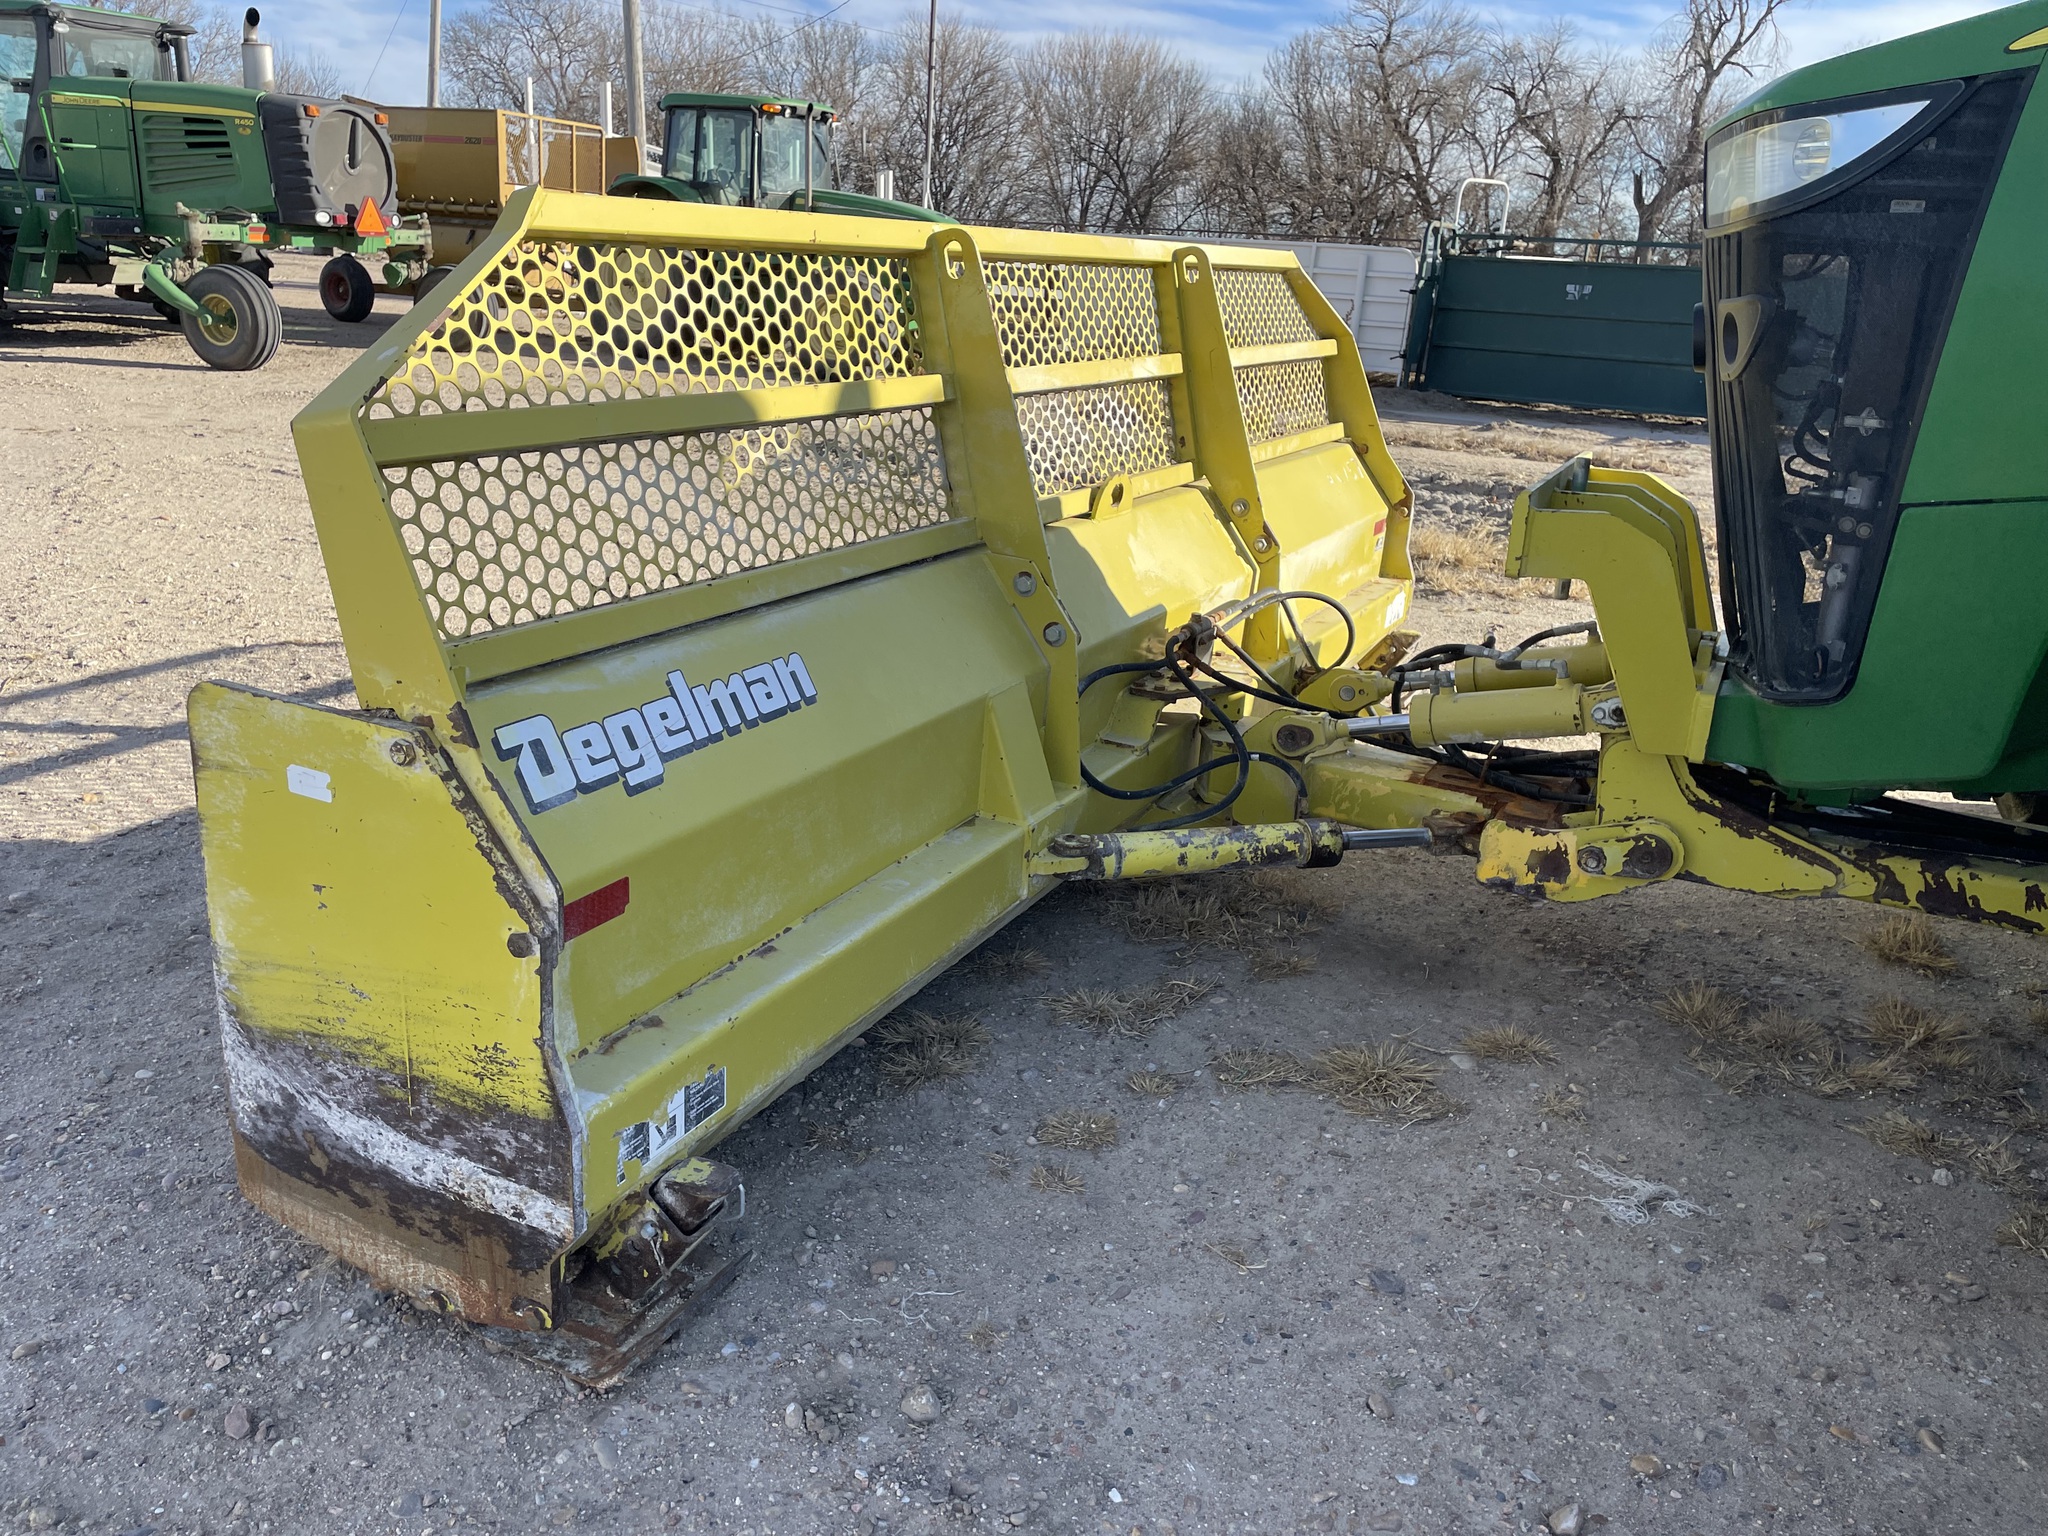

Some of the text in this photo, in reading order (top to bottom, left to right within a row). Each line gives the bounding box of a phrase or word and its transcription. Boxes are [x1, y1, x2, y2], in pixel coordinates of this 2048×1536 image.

[63, 96, 100, 105] JOHN DEERE
[234, 118, 255, 126] R450
[492, 652, 817, 814] Degelman
